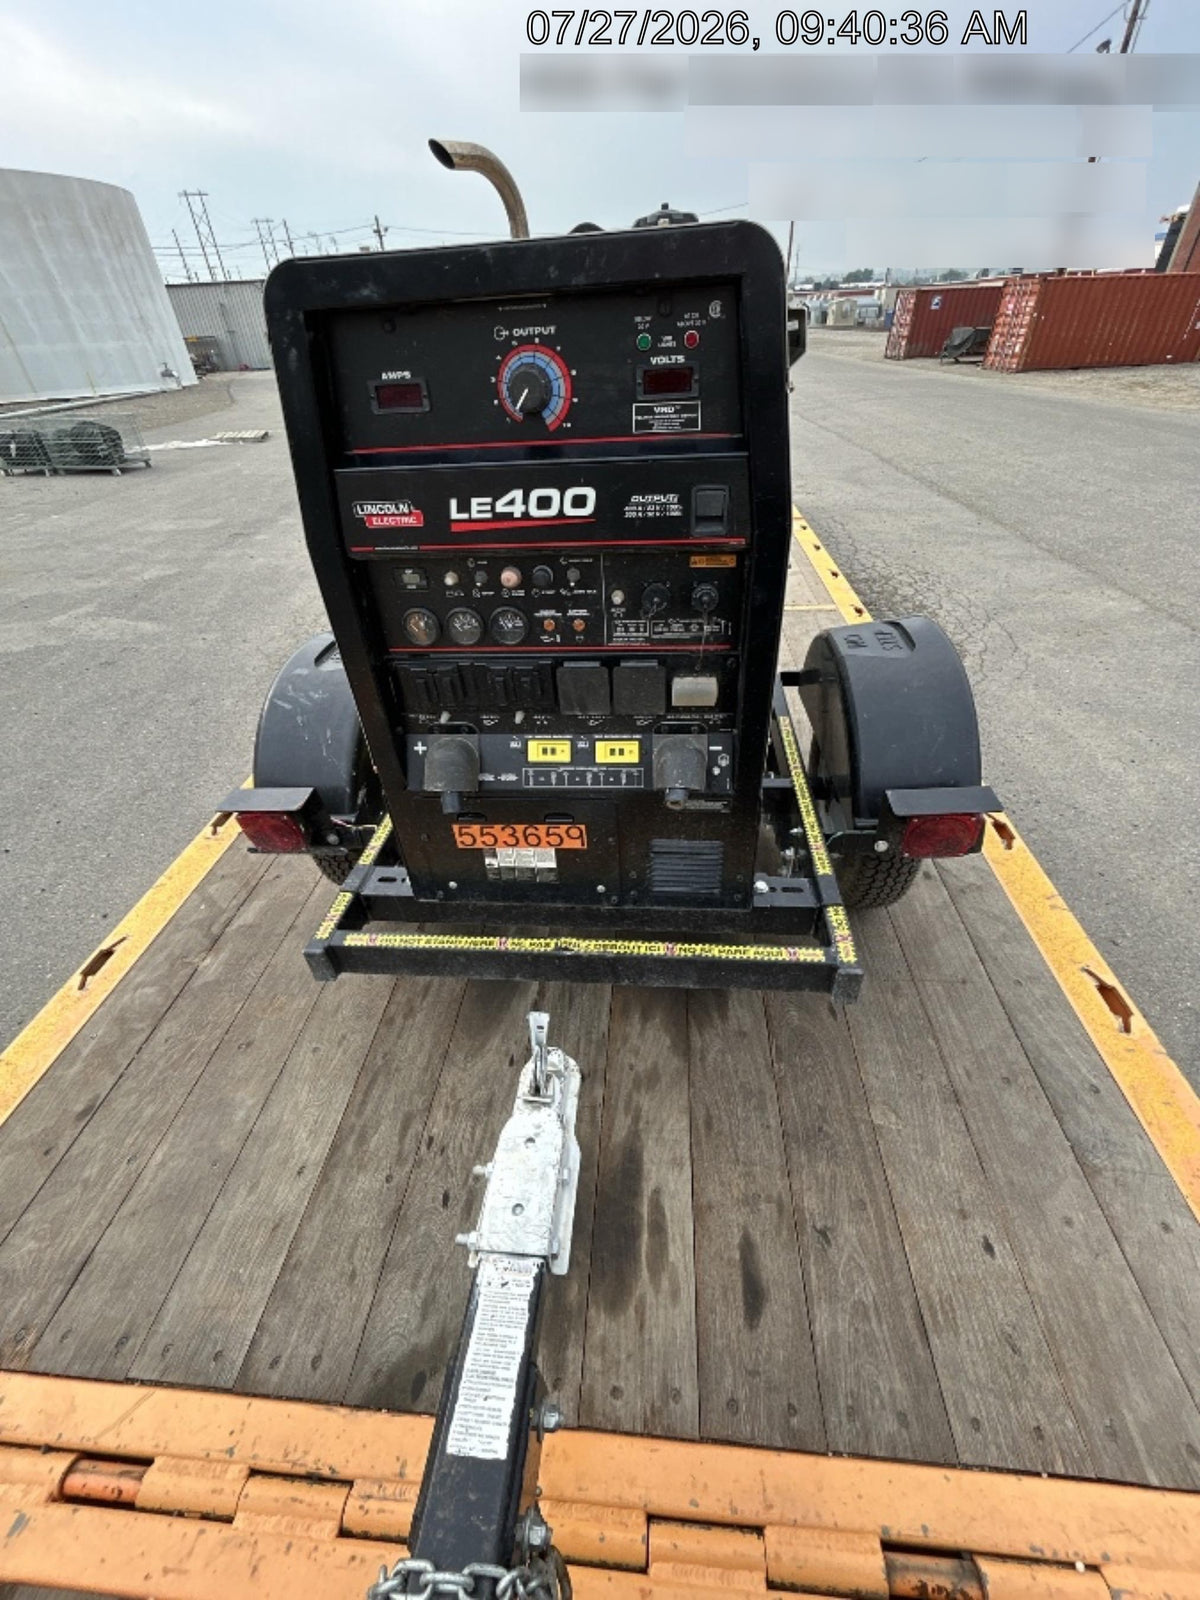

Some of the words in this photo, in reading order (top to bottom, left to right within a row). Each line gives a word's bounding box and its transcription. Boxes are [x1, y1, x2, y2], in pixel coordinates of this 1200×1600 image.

[513, 326, 556, 337] OUTPUT
[650, 355, 685, 364] VOLTS
[381, 370, 411, 380] AMPS
[356, 503, 409, 515] LINCOLN
[450, 487, 596, 520] LE400
[372, 516, 417, 525] ELECTRIC
[458, 825, 586, 848] 553659
